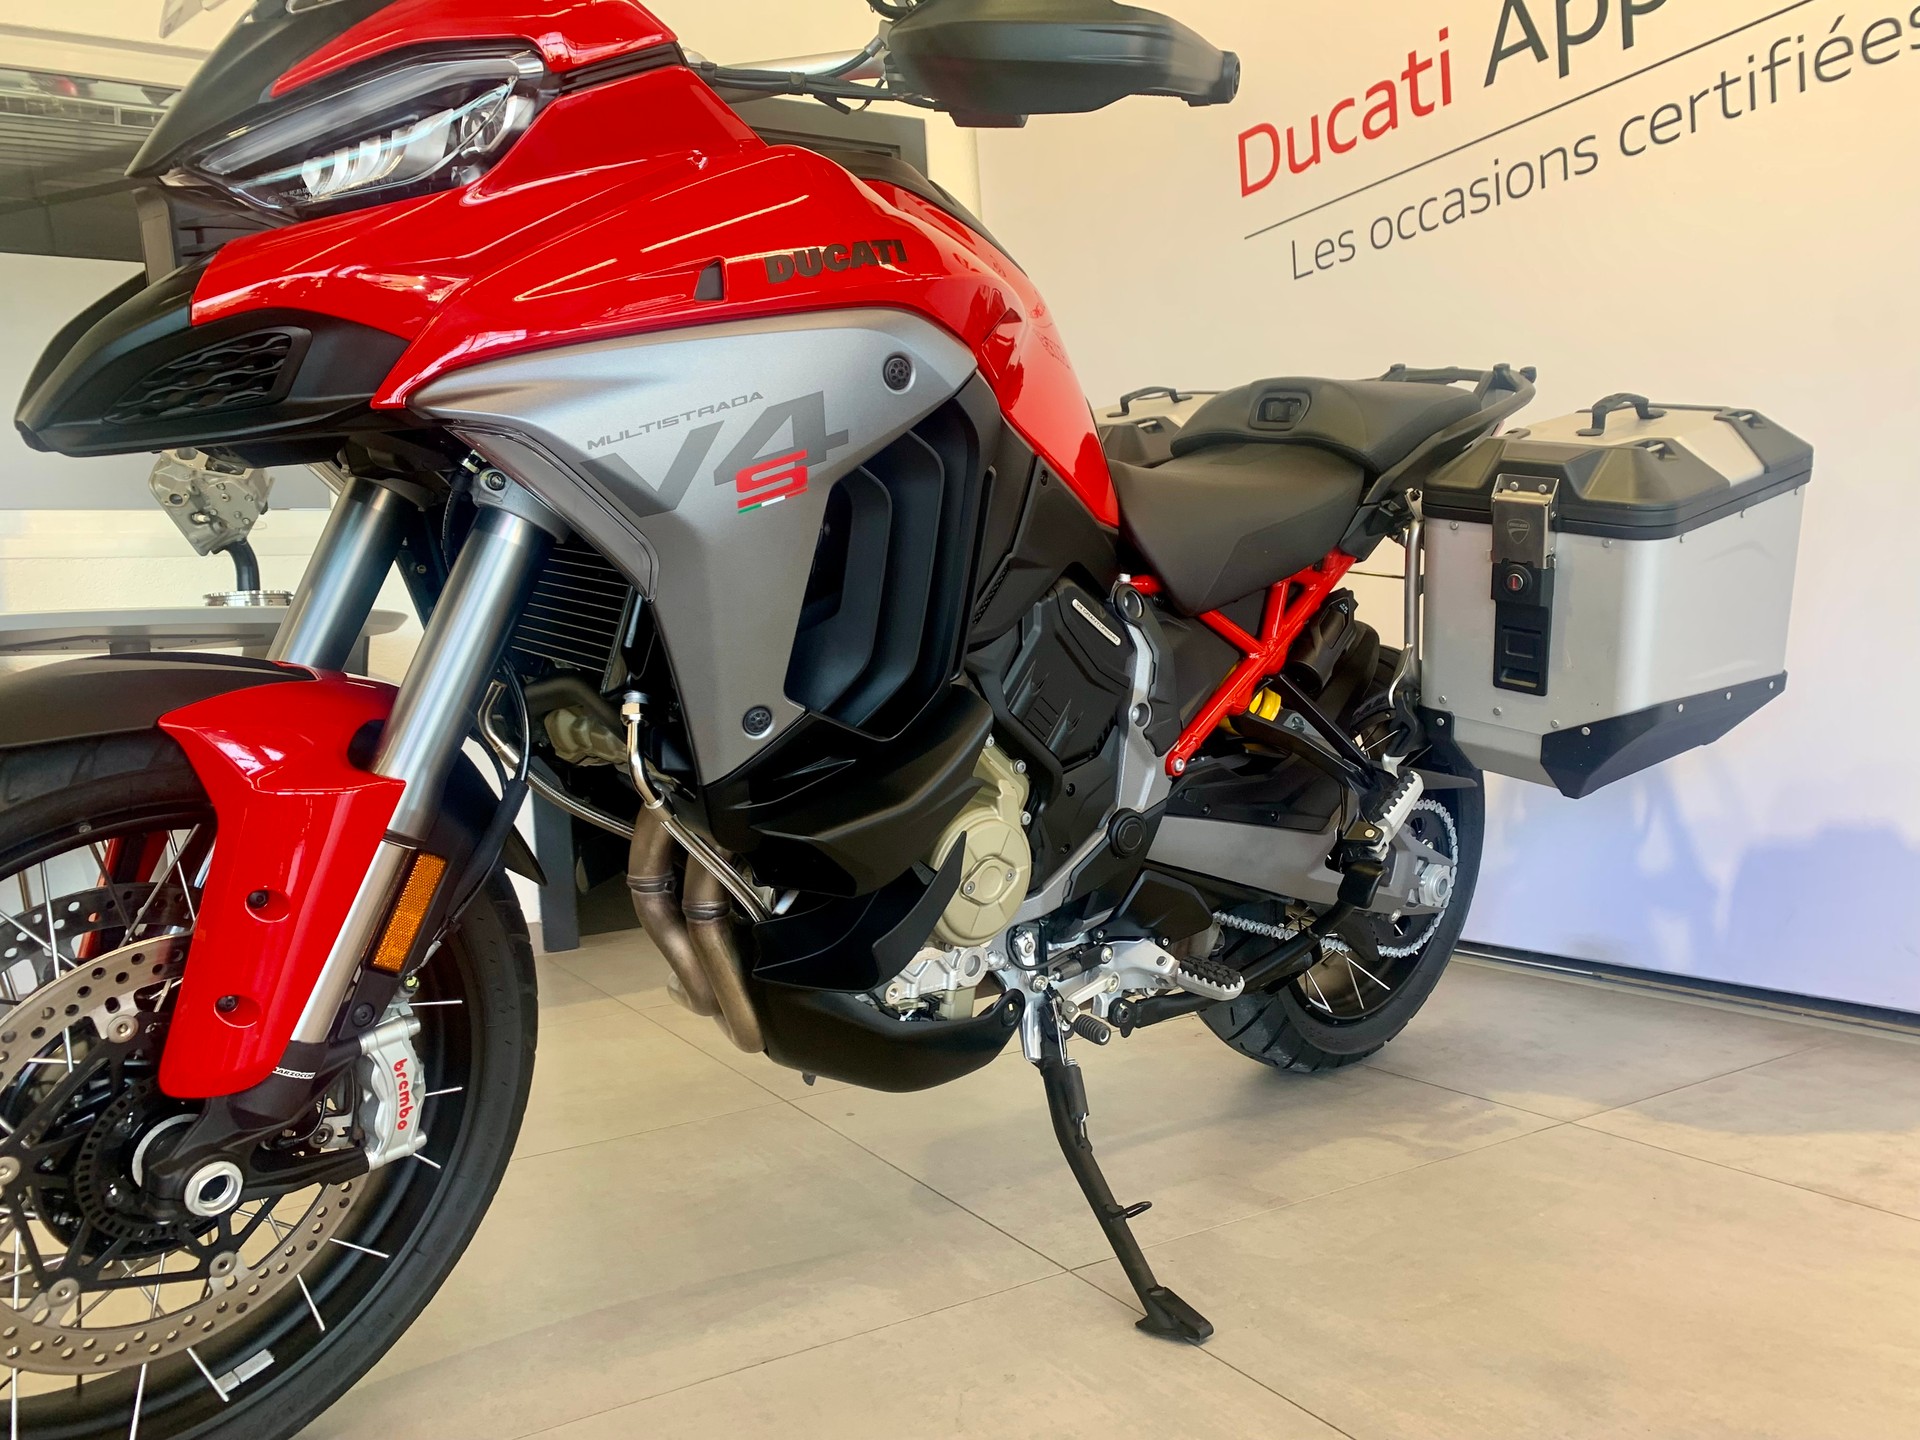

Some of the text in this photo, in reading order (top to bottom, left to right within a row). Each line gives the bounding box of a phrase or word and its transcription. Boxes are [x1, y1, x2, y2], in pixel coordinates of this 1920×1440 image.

[1237, 26, 1453, 198] Ducati
[1290, 226, 1357, 280] Les
[1369, 133, 1599, 252] occasions
[763, 239, 909, 285] DUCATI
[579, 390, 849, 518] V4 S
[587, 391, 764, 450] MULTISTRADA
[393, 1058, 414, 1131] brembo
